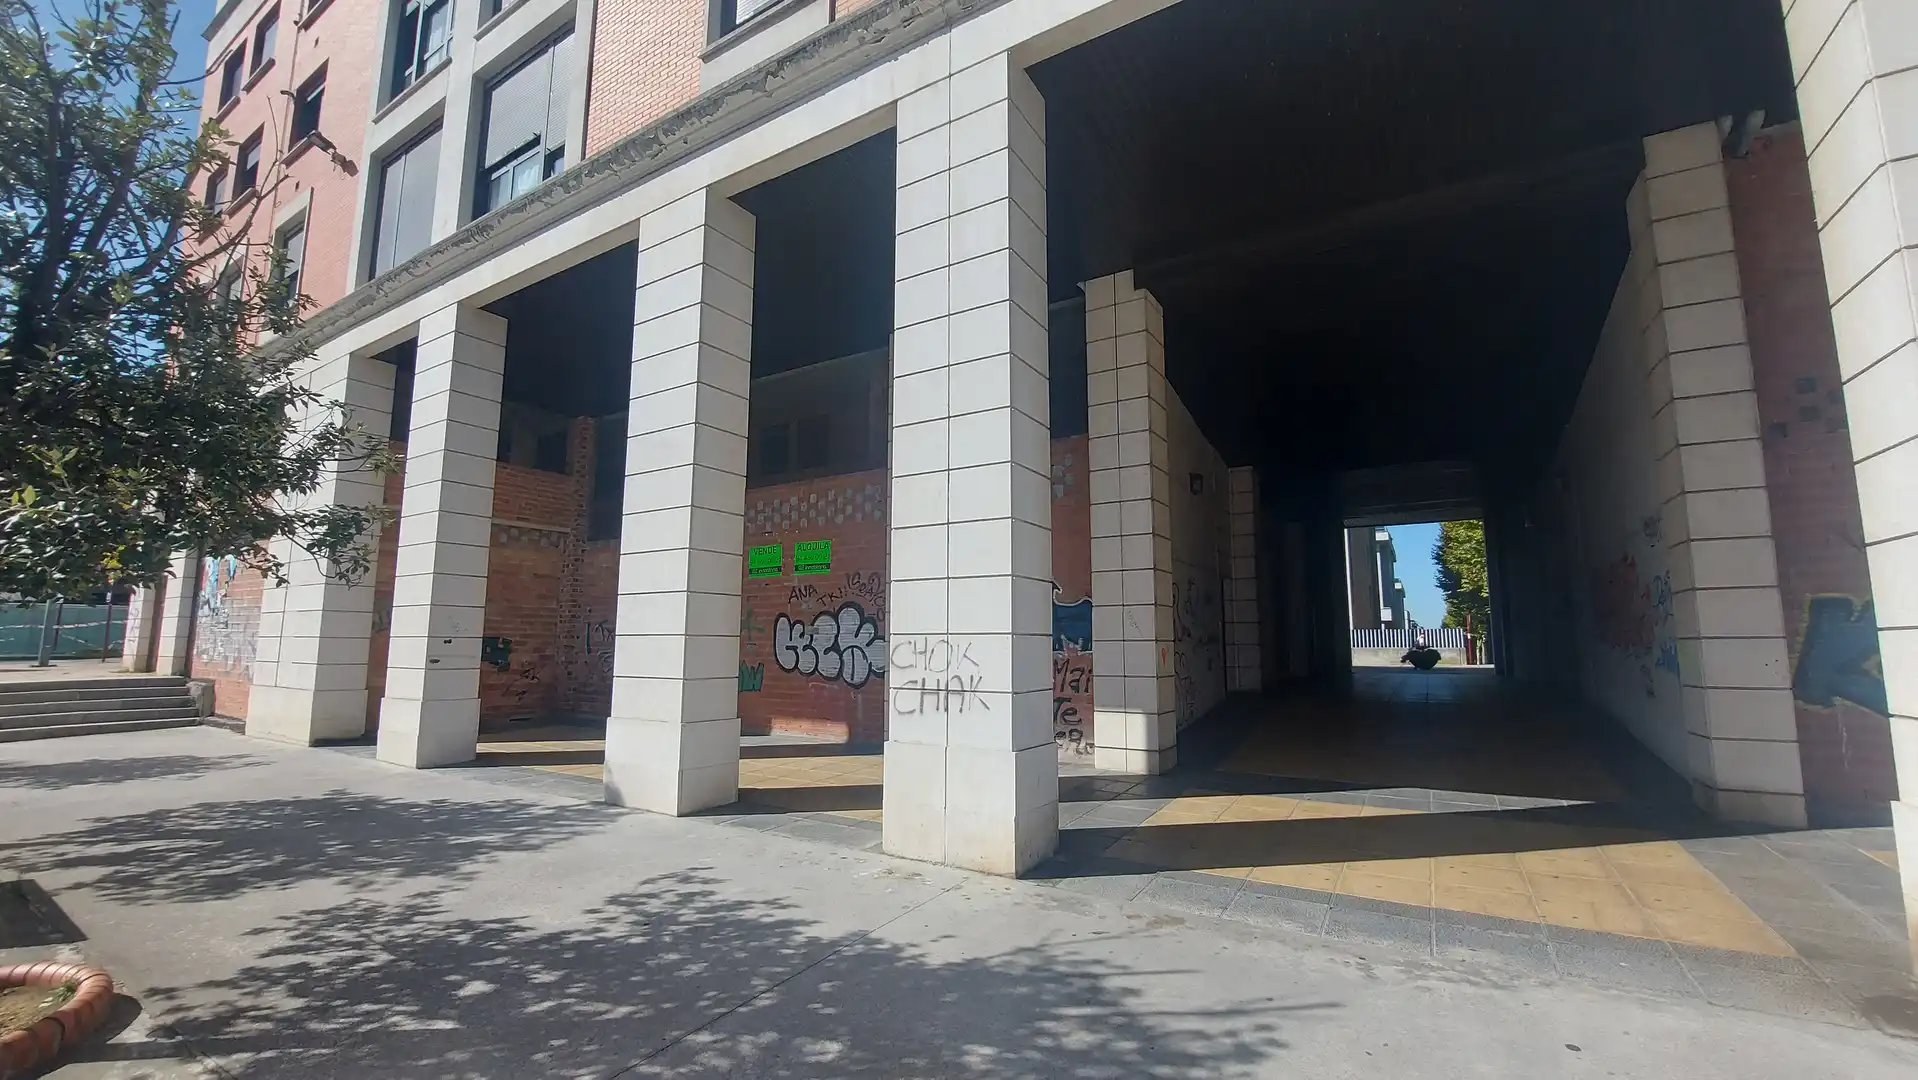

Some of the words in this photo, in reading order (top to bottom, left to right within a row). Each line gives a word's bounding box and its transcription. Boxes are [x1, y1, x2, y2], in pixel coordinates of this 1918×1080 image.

[752, 546, 777, 556] VENDE
[796, 541, 829, 552] ALQUILA
[890, 636, 980, 673] CHOK
[893, 673, 990, 716] CHAK
